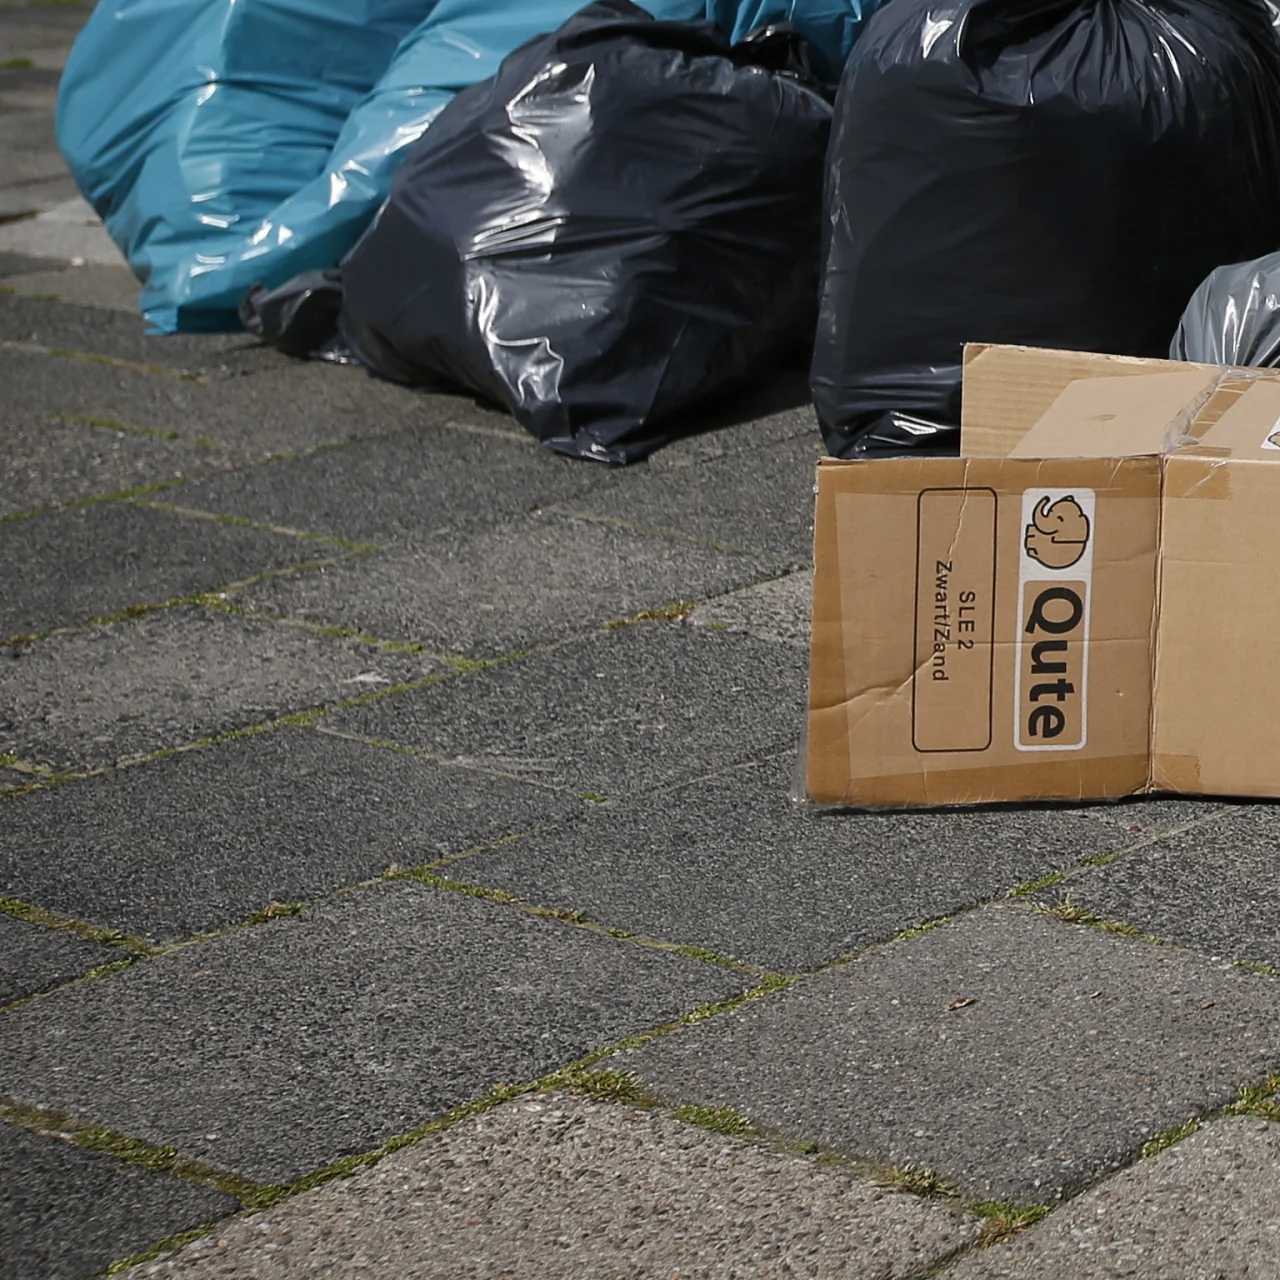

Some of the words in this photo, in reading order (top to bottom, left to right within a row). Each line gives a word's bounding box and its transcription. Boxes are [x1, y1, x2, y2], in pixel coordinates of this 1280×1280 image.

[932, 560, 953, 681] Zwart/Zand
[957, 639, 974, 650] 2
[959, 590, 976, 633] SLE
[1025, 587, 1083, 738] Qute
